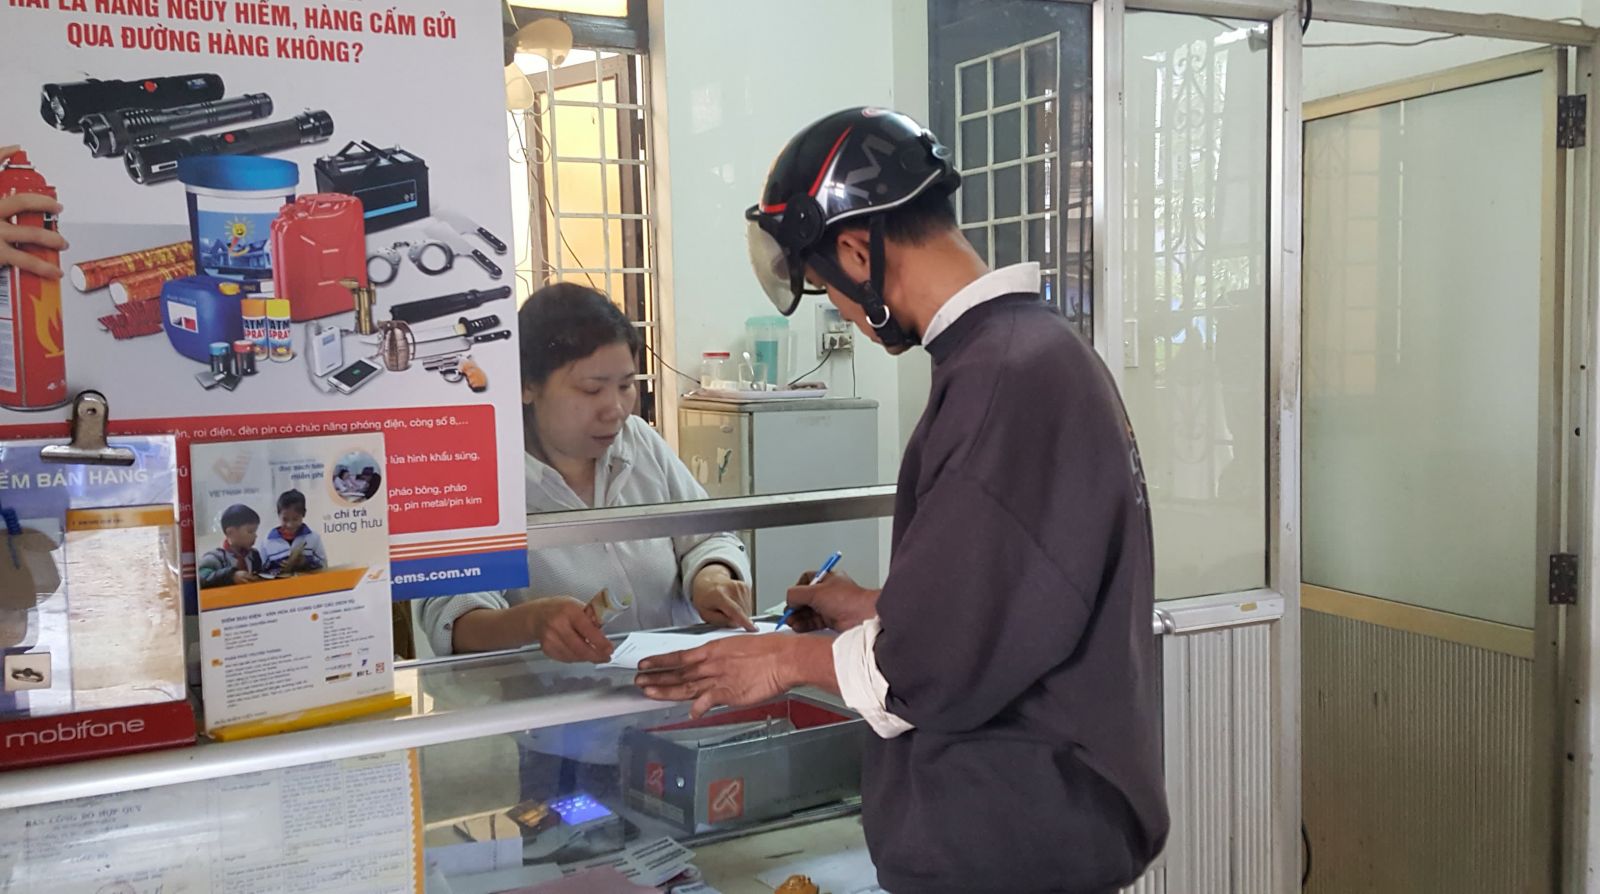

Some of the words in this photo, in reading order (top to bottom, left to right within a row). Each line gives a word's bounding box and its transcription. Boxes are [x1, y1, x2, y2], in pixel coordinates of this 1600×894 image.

[168, 0, 227, 22] NGUY
[304, 3, 363, 32] HÀNG
[370, 6, 416, 36] CẤM
[423, 11, 456, 39] GỬI
[67, 22, 114, 48] QUA
[121, 23, 201, 53] ĐƯỜNG
[208, 29, 269, 57] HÀNG
[276, 35, 364, 63] KHÔNG?
[210, 427, 236, 439] điện,
[261, 426, 277, 438] pin
[280, 424, 293, 434] có
[295, 422, 320, 433] chức
[350, 419, 382, 433] phóng
[37, 468, 82, 488] BÁN
[89, 466, 149, 486] HÀNG
[334, 509, 350, 520] chi
[404, 499, 420, 511] pin
[466, 496, 482, 506] kim
[6, 719, 144, 748] mobifone
